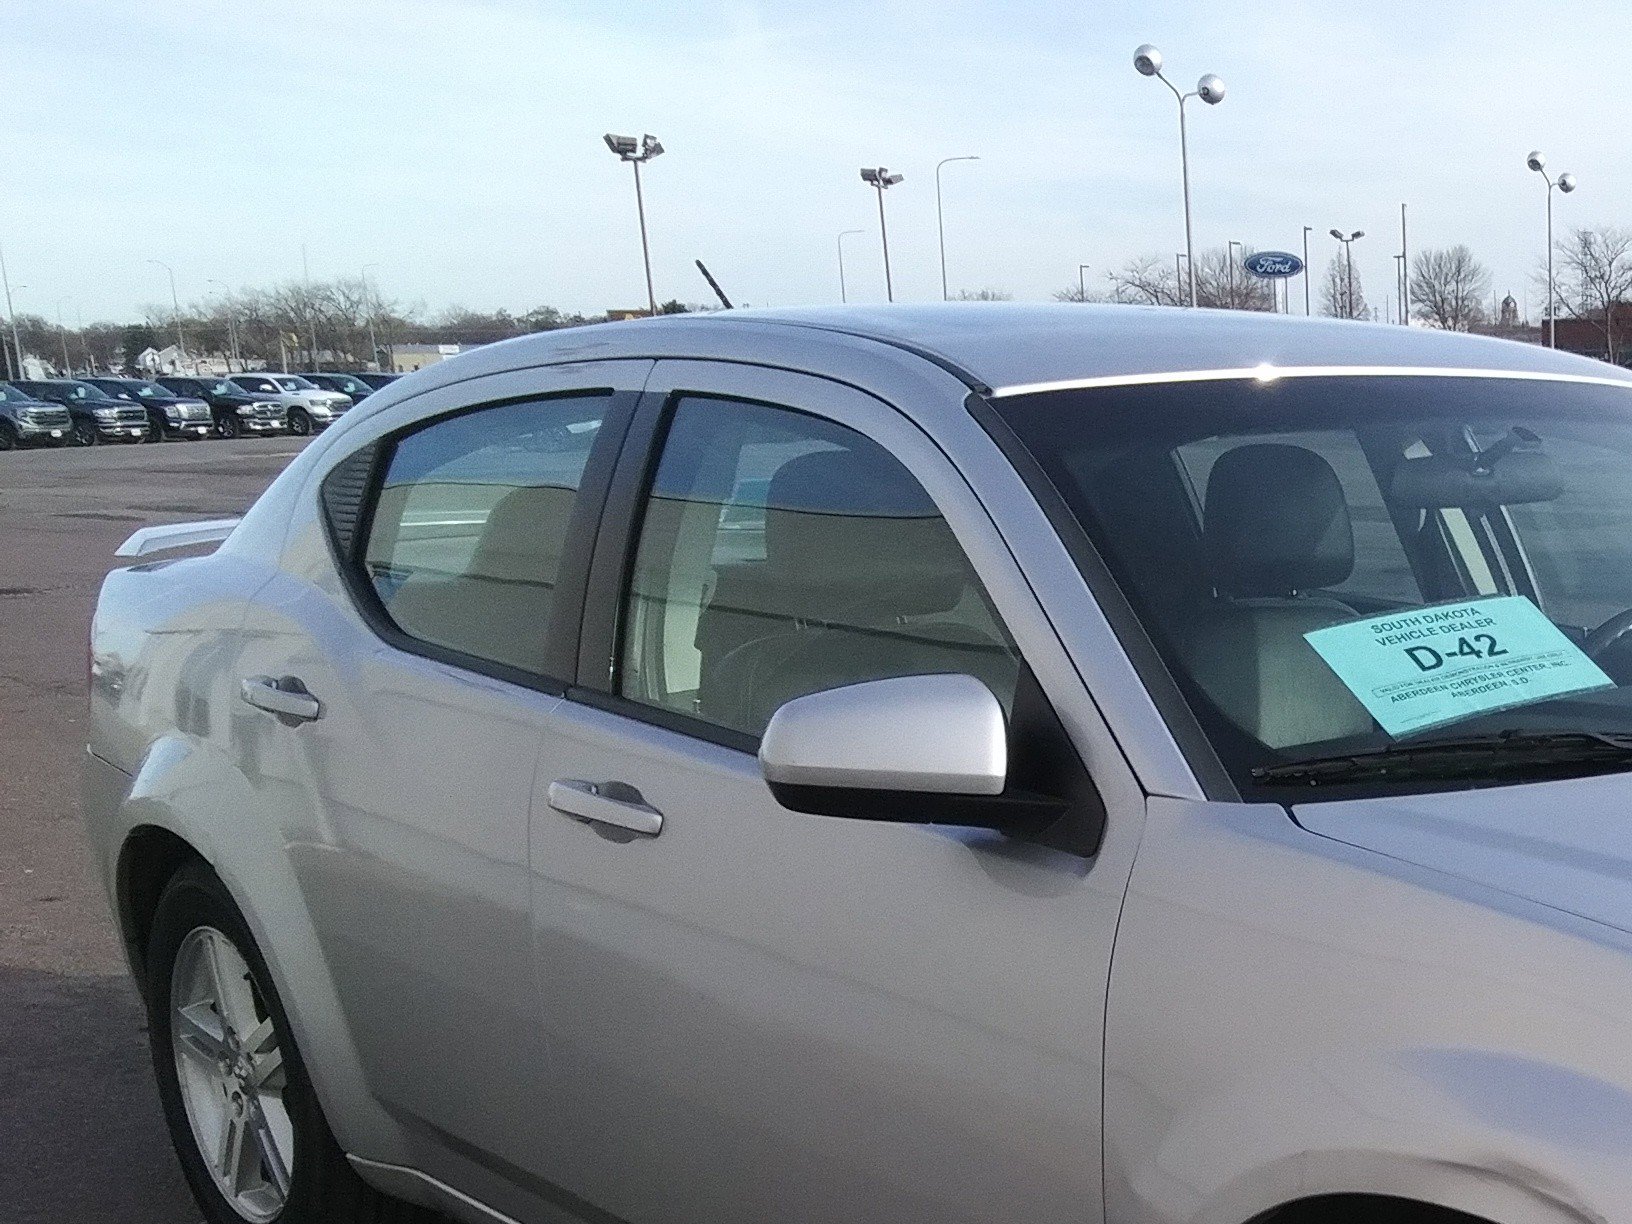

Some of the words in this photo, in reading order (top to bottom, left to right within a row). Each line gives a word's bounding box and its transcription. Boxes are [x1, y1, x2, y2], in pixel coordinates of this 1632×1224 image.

[1257, 256, 1292, 273] Ford
[1371, 616, 1422, 634] SOUTH
[1422, 607, 1482, 624] DAKOTA
[1375, 627, 1440, 647] VEHICLE
[1439, 617, 1497, 634] DEALER
[1403, 633, 1509, 672] D-42
[1390, 684, 1449, 704] ABERDEEN
